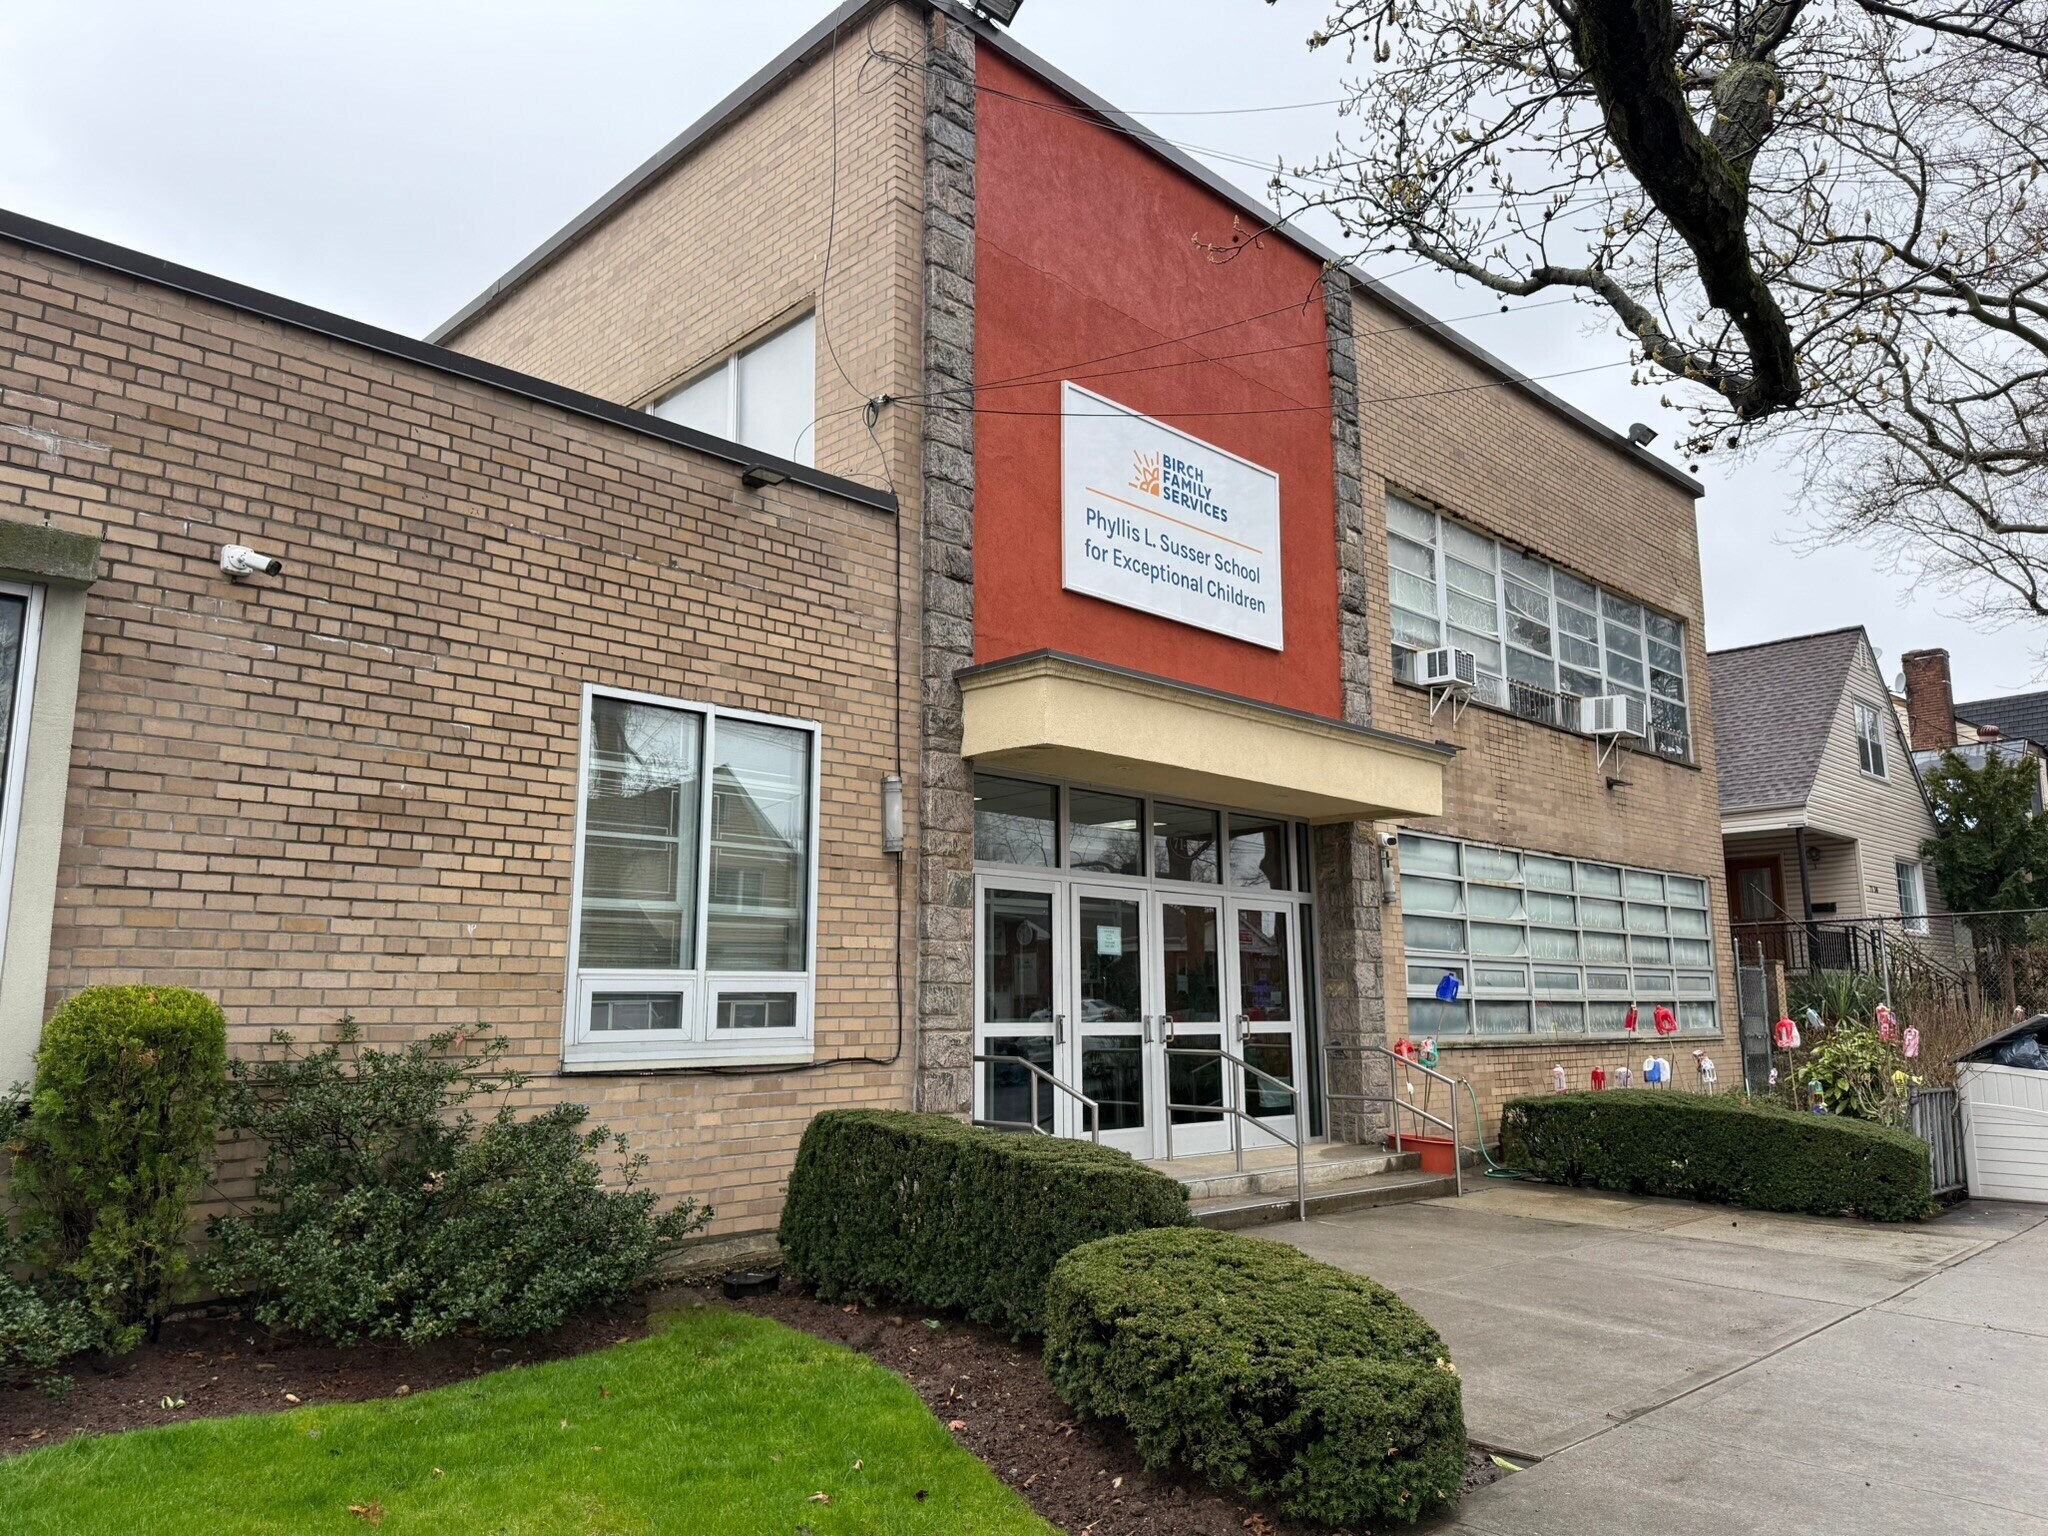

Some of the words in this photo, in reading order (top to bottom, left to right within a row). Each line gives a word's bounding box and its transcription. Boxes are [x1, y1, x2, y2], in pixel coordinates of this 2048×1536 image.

[1163, 454, 1203, 483] BIRCH
[1163, 470, 1212, 500] FAMILY
[1163, 487, 1228, 523] SERVICES
[1086, 507, 1140, 542] Phyllis
[1145, 528, 1156, 548] L.
[1160, 534, 1211, 566] Susser
[1214, 553, 1260, 584] School
[1085, 538, 1108, 562] for
[1113, 548, 1203, 594] Exceptional
[1207, 580, 1265, 614] Children
